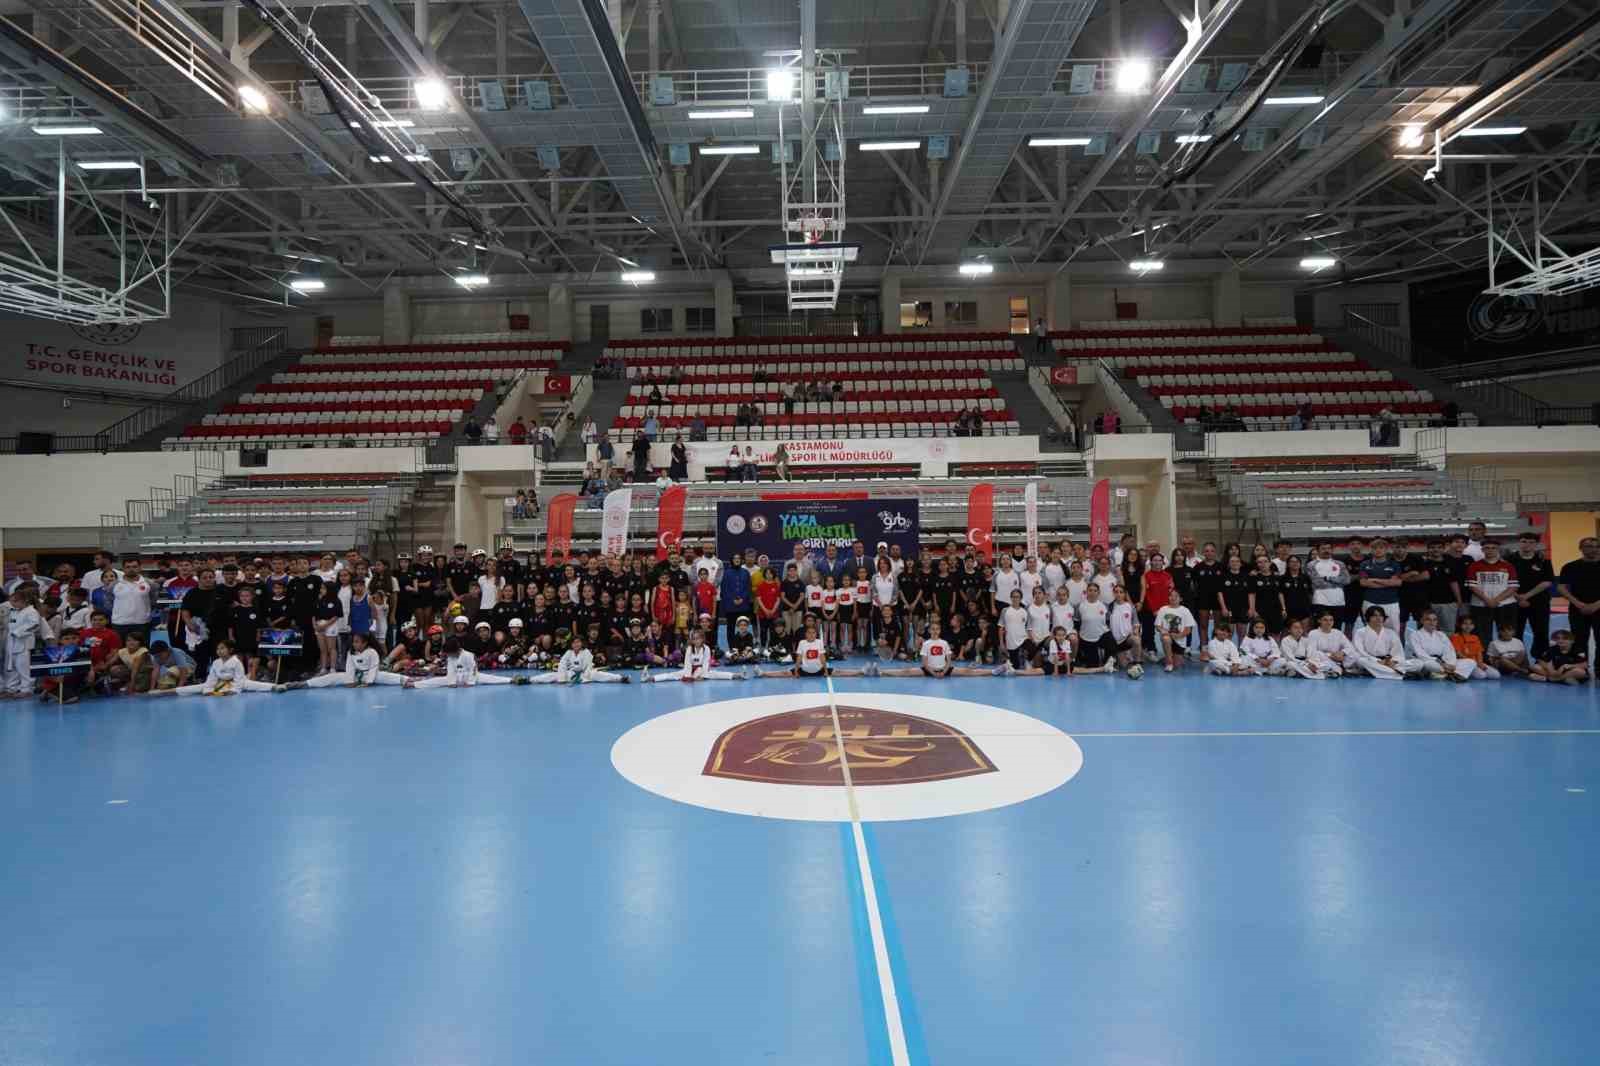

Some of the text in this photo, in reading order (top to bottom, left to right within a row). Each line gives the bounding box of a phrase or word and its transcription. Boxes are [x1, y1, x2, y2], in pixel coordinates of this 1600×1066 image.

[27, 344, 61, 358] T.C.
[154, 359, 177, 371] VE
[26, 359, 77, 375] SPOR
[784, 441, 844, 452] KASTAMONU
[791, 453, 817, 463] SPOR
[831, 450, 893, 461] MÜDÜRLÜĞÜ
[778, 513, 817, 528] YAZA
[783, 522, 857, 540] HAREKETLİ
